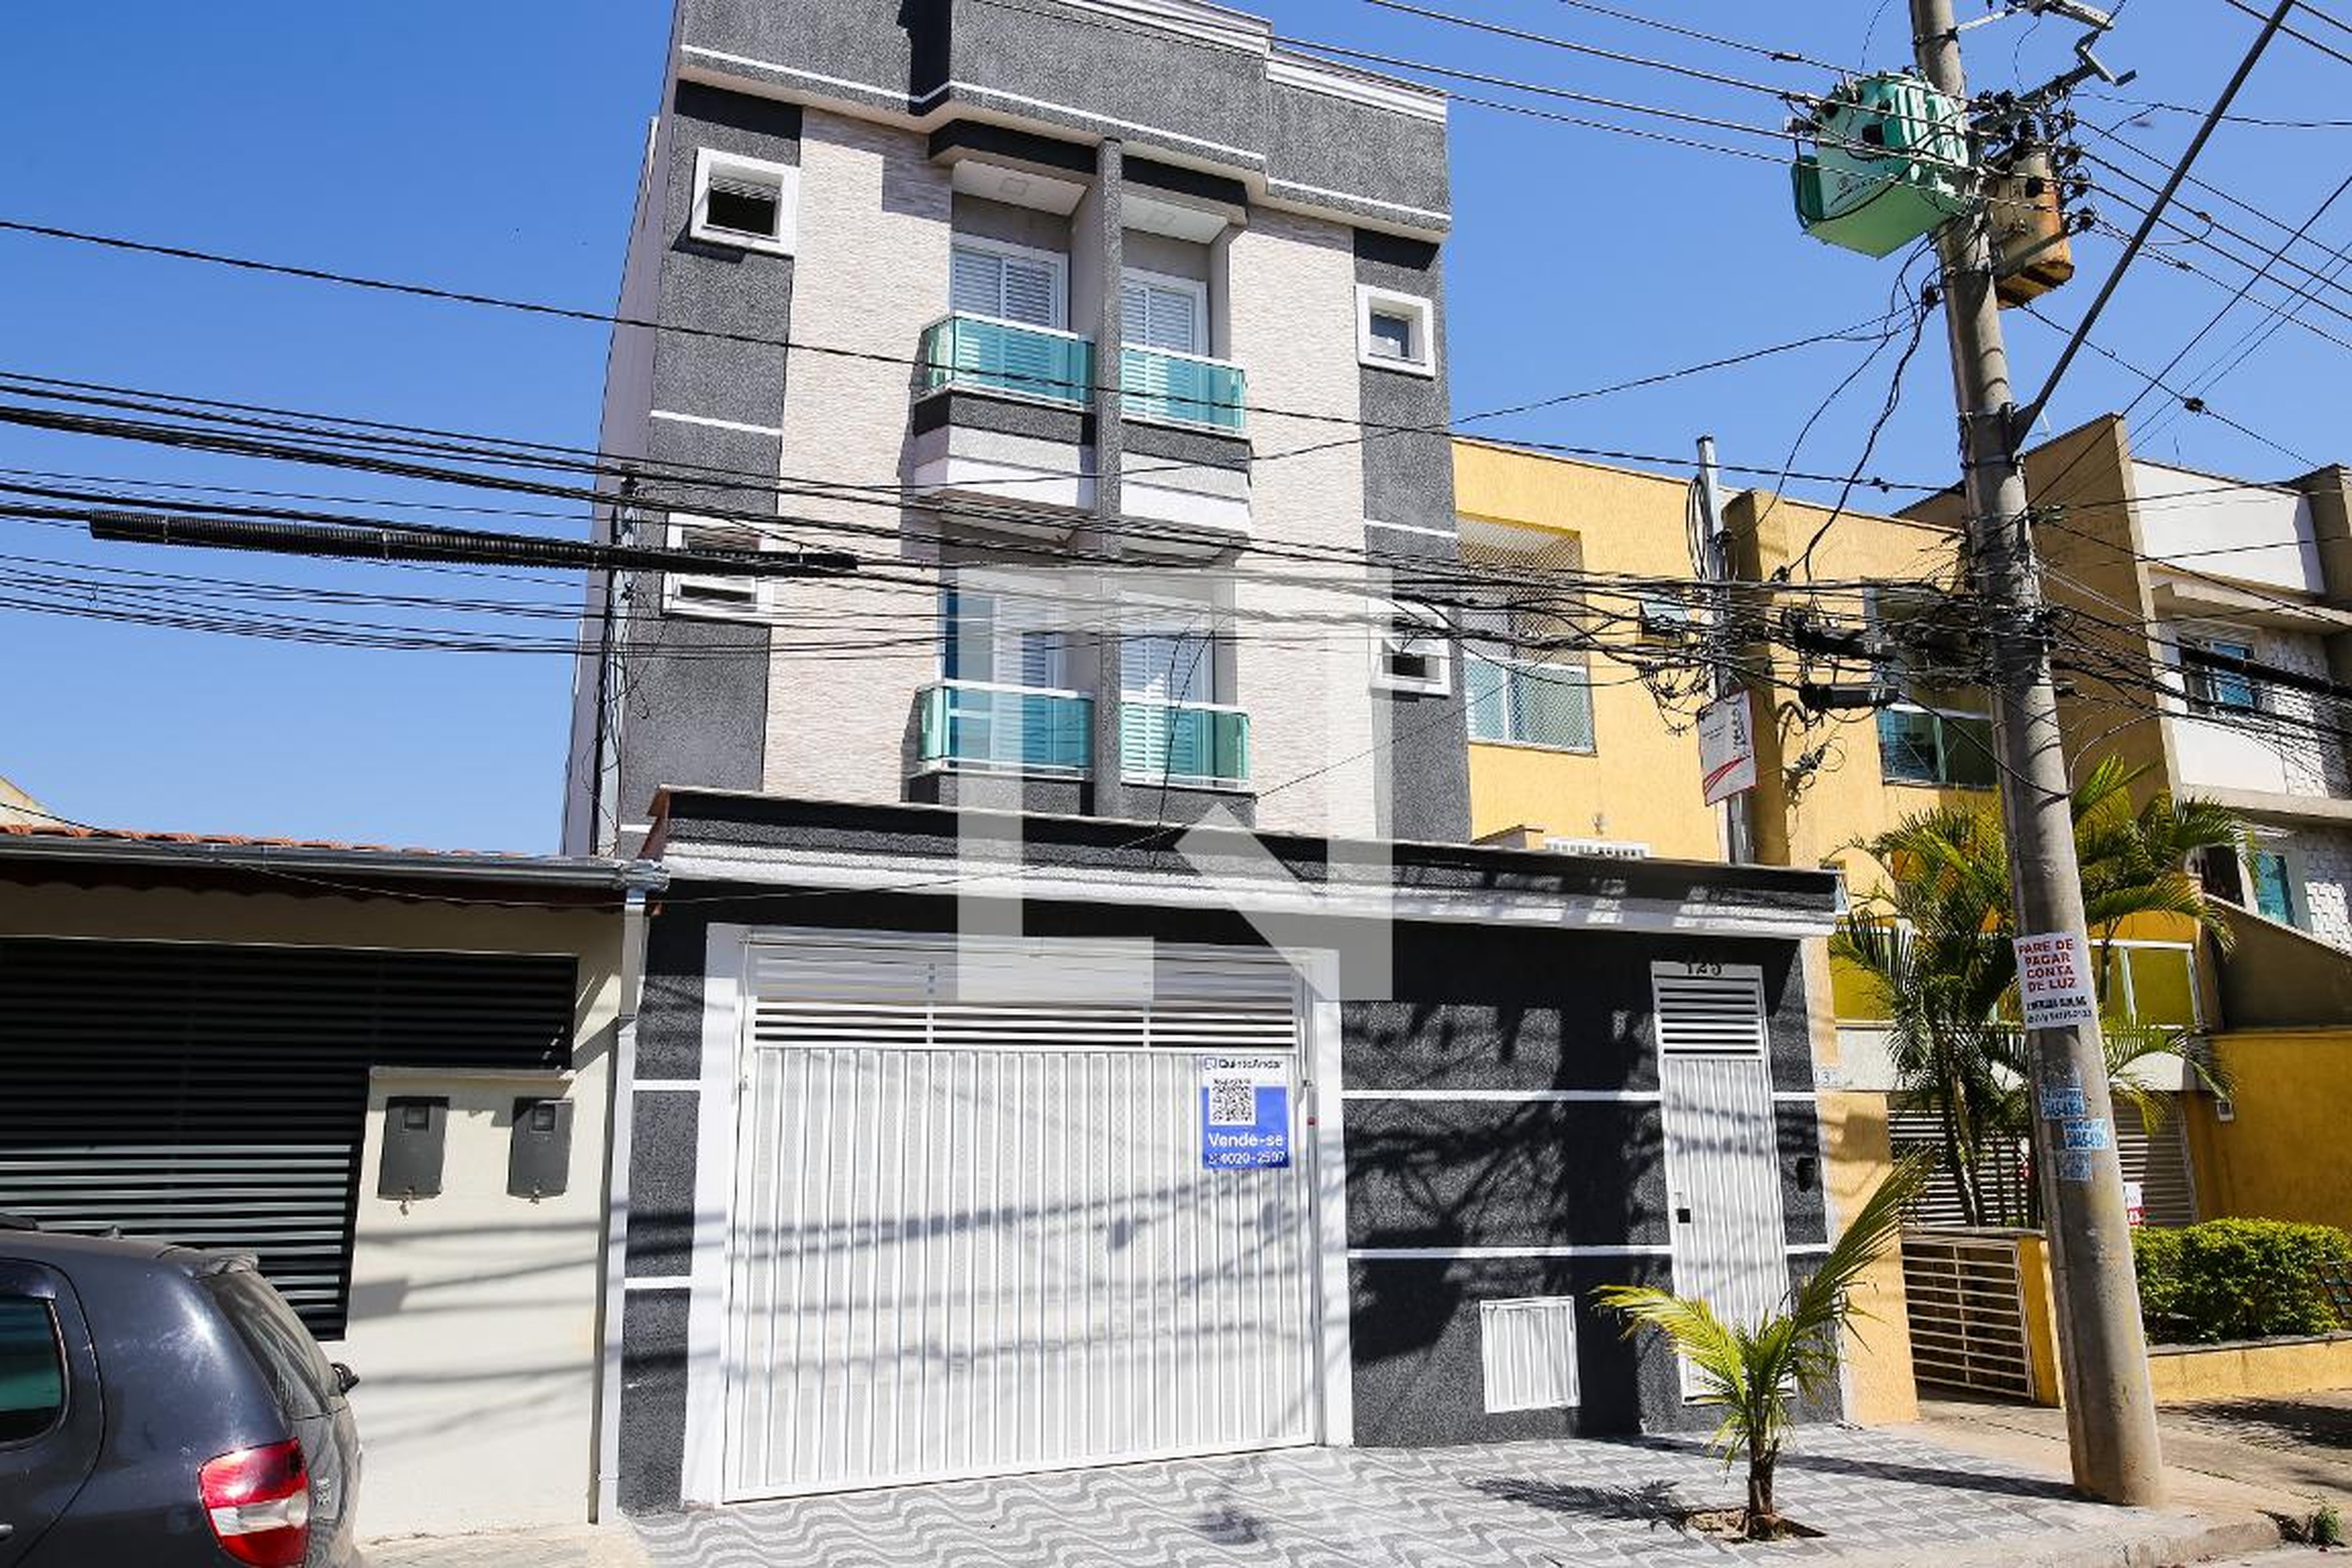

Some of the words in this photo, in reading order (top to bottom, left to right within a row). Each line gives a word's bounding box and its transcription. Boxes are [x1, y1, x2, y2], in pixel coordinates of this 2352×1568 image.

[2019, 941, 2051, 954] PARE
[2056, 938, 2074, 950] DE
[2024, 952, 2071, 967] PAGAR
[2027, 965, 2074, 979] CONTA
[2028, 981, 2046, 993] DE
[2049, 978, 2076, 989] LUZ
[1208, 1133, 1284, 1147] Vende-se
